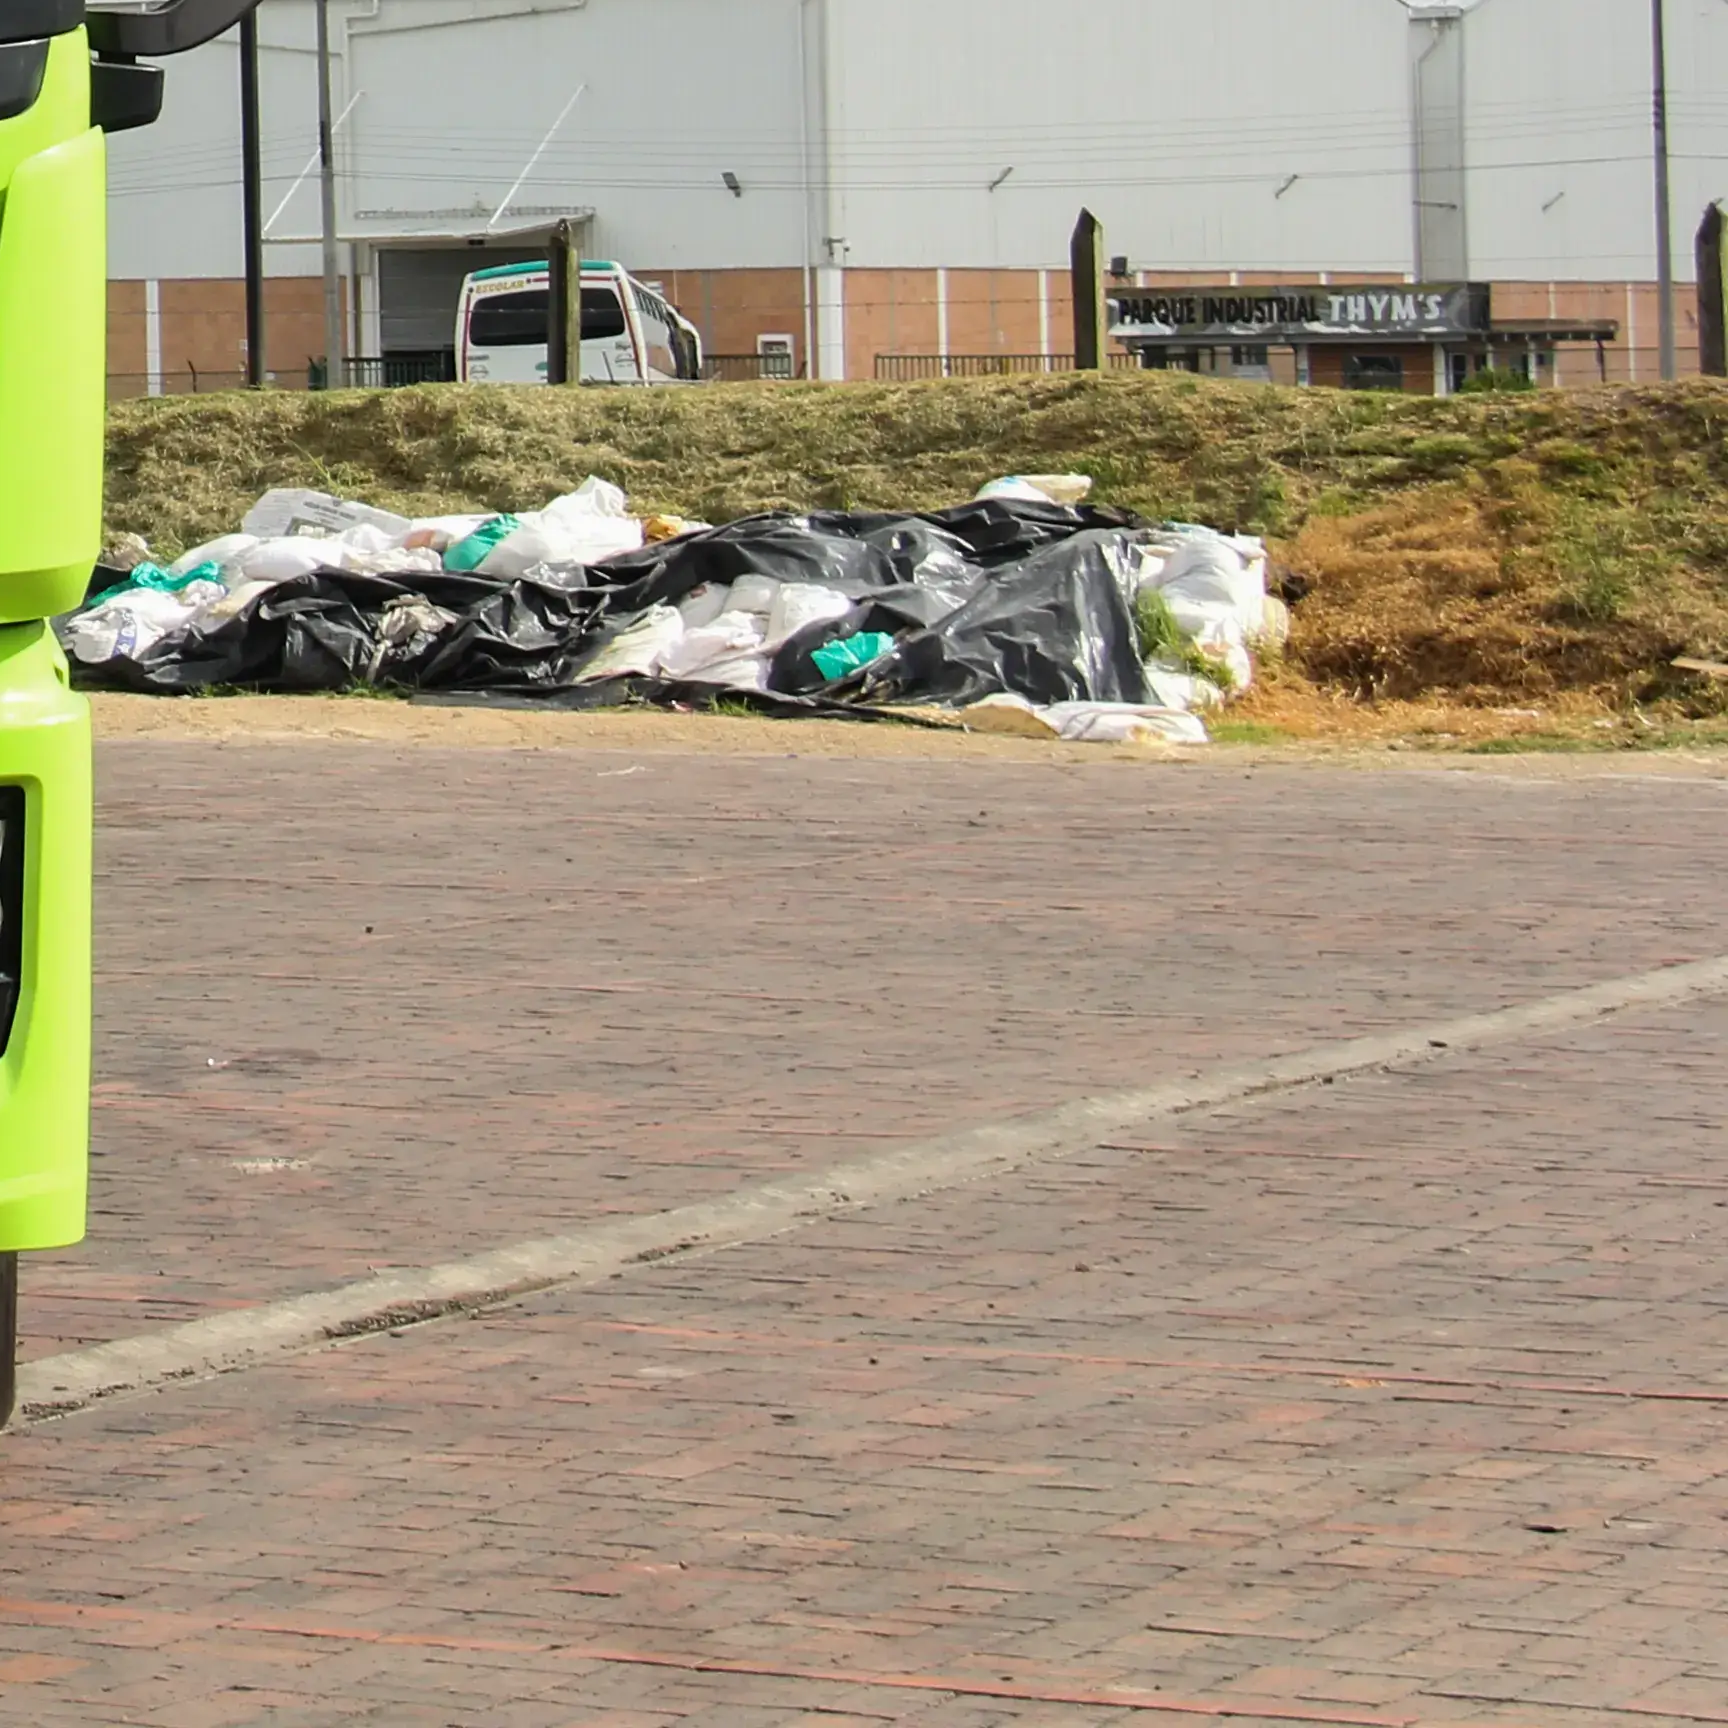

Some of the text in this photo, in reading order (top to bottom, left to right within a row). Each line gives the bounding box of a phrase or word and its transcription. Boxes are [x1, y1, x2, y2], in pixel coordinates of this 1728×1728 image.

[1119, 294, 1442, 324] PARQUE INDUSTRIAL THYM'S
